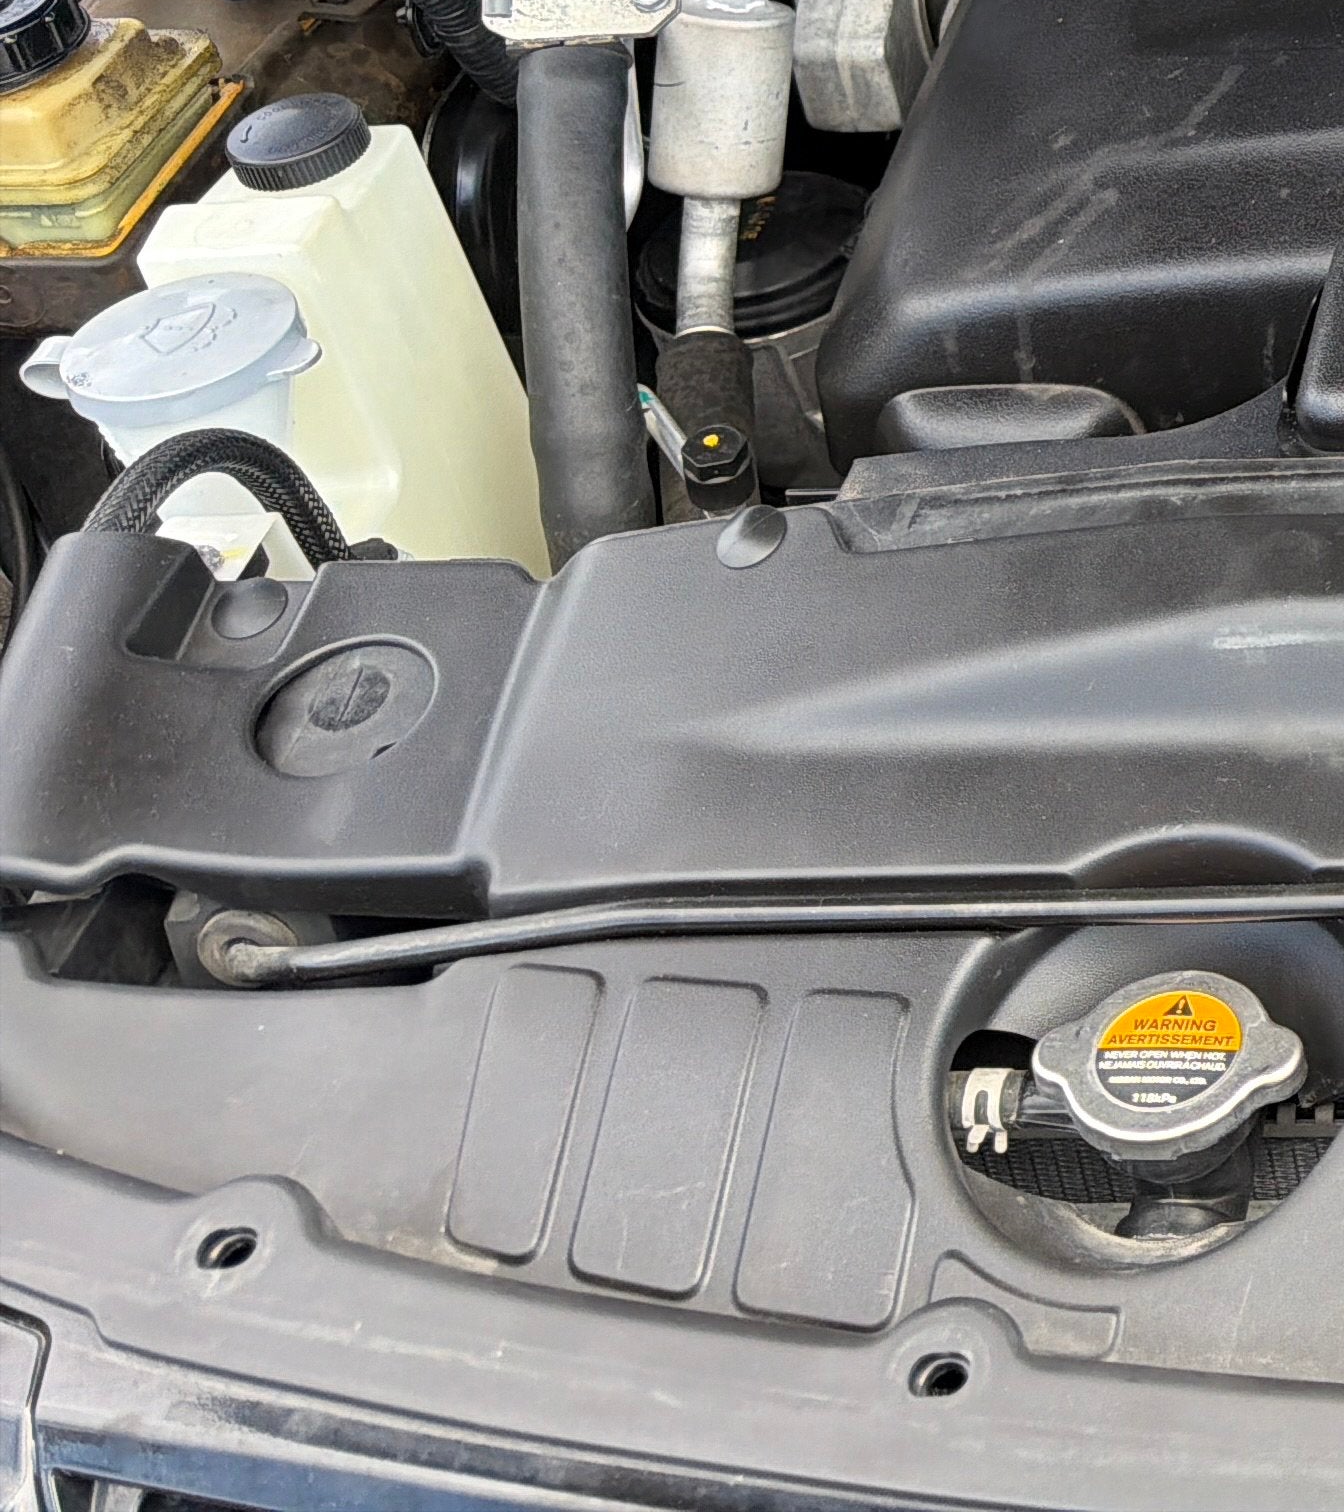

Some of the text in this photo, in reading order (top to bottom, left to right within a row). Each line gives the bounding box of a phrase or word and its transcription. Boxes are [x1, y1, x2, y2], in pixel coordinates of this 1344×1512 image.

[1133, 1019, 1217, 1032] WARNING
[1107, 1034, 1234, 1047] AVERTISSEMENT
[1104, 1050, 1138, 1059] NEVER
[1140, 1051, 1168, 1059] OPEN
[1170, 1051, 1201, 1060] WHEN
